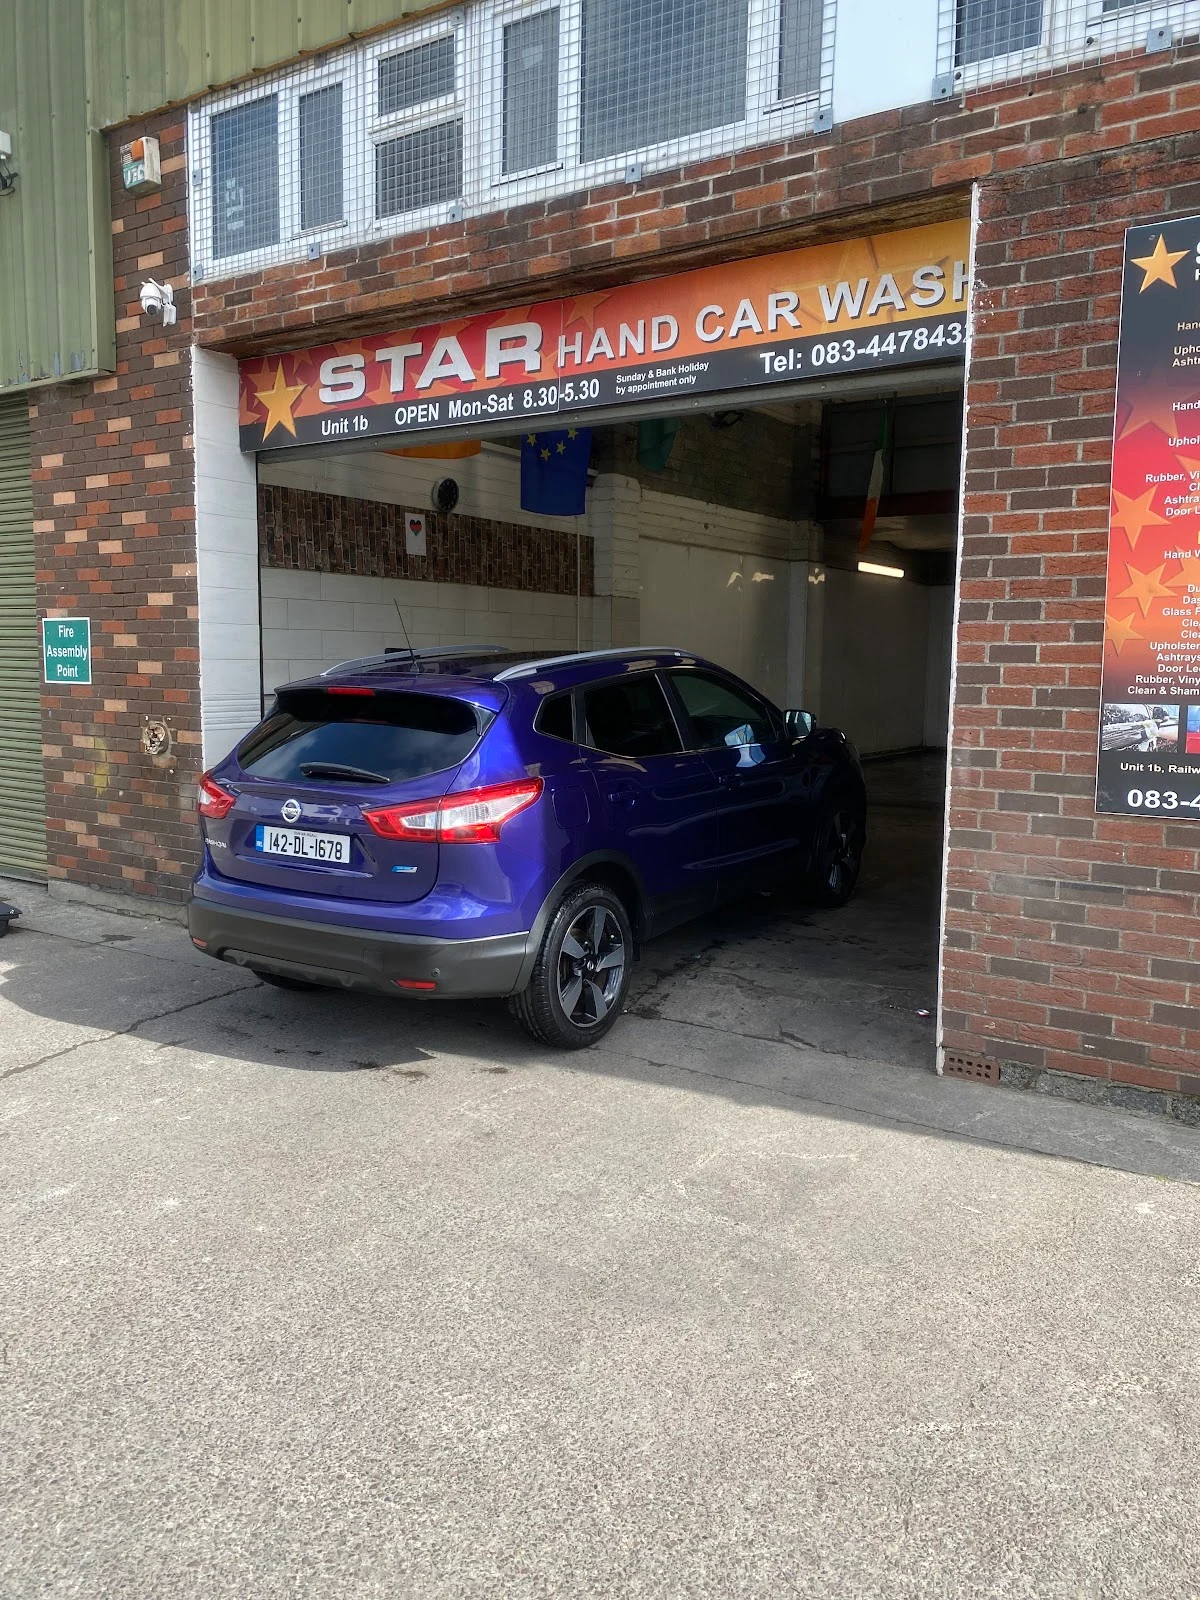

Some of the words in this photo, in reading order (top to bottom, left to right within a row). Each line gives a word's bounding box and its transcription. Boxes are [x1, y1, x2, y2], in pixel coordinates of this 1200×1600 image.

[1177, 322, 1200, 331] Han
[318, 321, 544, 404] STAR
[557, 314, 680, 369] HAND
[695, 290, 802, 343] CAR
[759, 348, 802, 374] Tel:
[811, 322, 967, 367] 083-447843
[616, 371, 646, 383] Sunday
[648, 369, 655, 379] &
[656, 366, 677, 377] Bank
[678, 361, 710, 373] Holiday
[615, 385, 626, 395] by
[627, 378, 677, 393] appointment
[679, 374, 697, 385] only
[394, 402, 440, 425] OPEN
[448, 392, 514, 419] Mon-Sat
[522, 378, 600, 409] 8.30-5.30
[1172, 399, 1200, 411] Hand
[321, 418, 349, 436] Unit
[352, 414, 369, 432] 1b
[1168, 435, 1200, 448] Uphol
[1145, 473, 1186, 483] Rubber,
[1165, 507, 1192, 516] Door
[1164, 549, 1192, 559] Hand
[1162, 607, 1192, 616] Glass
[1182, 618, 1200, 627] Cle
[58, 624, 75, 638] Fire
[46, 644, 88, 661] Assembly
[57, 663, 79, 677] Point
[1157, 663, 1184, 672] Door
[1186, 663, 1200, 672] Le
[1135, 674, 1175, 685] Rubber,
[1178, 675, 1200, 686] Viny
[1127, 685, 1157, 694] Clean
[1159, 686, 1167, 695] &
[1170, 686, 1200, 695] Sham
[1120, 762, 1144, 771] Unit
[1147, 764, 1164, 773] 1b,
[269, 832, 343, 860] 142-DL-1678
